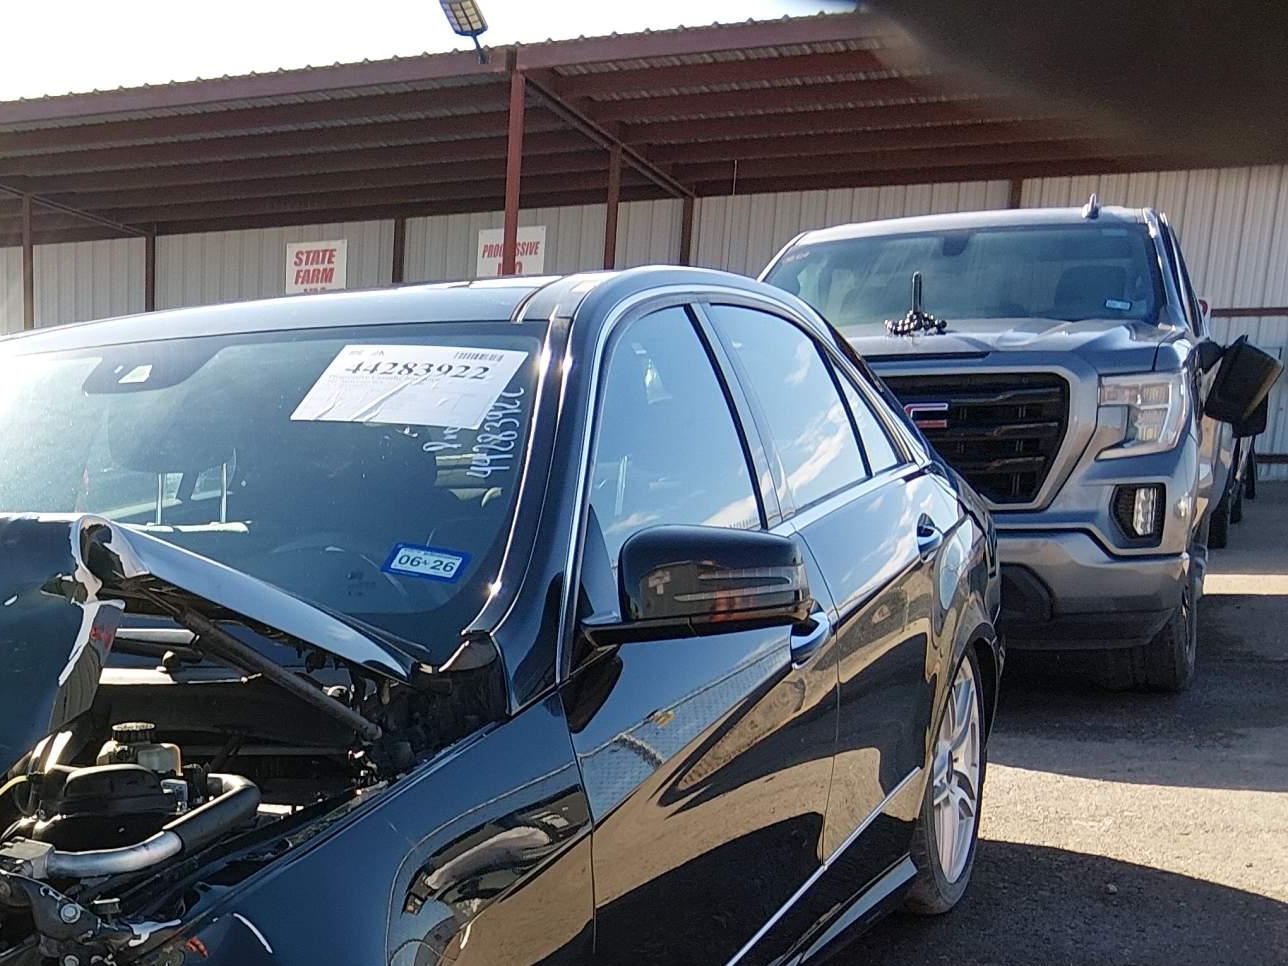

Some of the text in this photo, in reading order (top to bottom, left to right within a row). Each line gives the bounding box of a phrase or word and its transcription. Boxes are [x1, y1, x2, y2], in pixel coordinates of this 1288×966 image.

[294, 248, 336, 266] STATE
[482, 241, 540, 258] PROSSIVE
[295, 267, 334, 284] FARM
[345, 360, 490, 380] 44283922
[398, 554, 456, 573] 06 26
